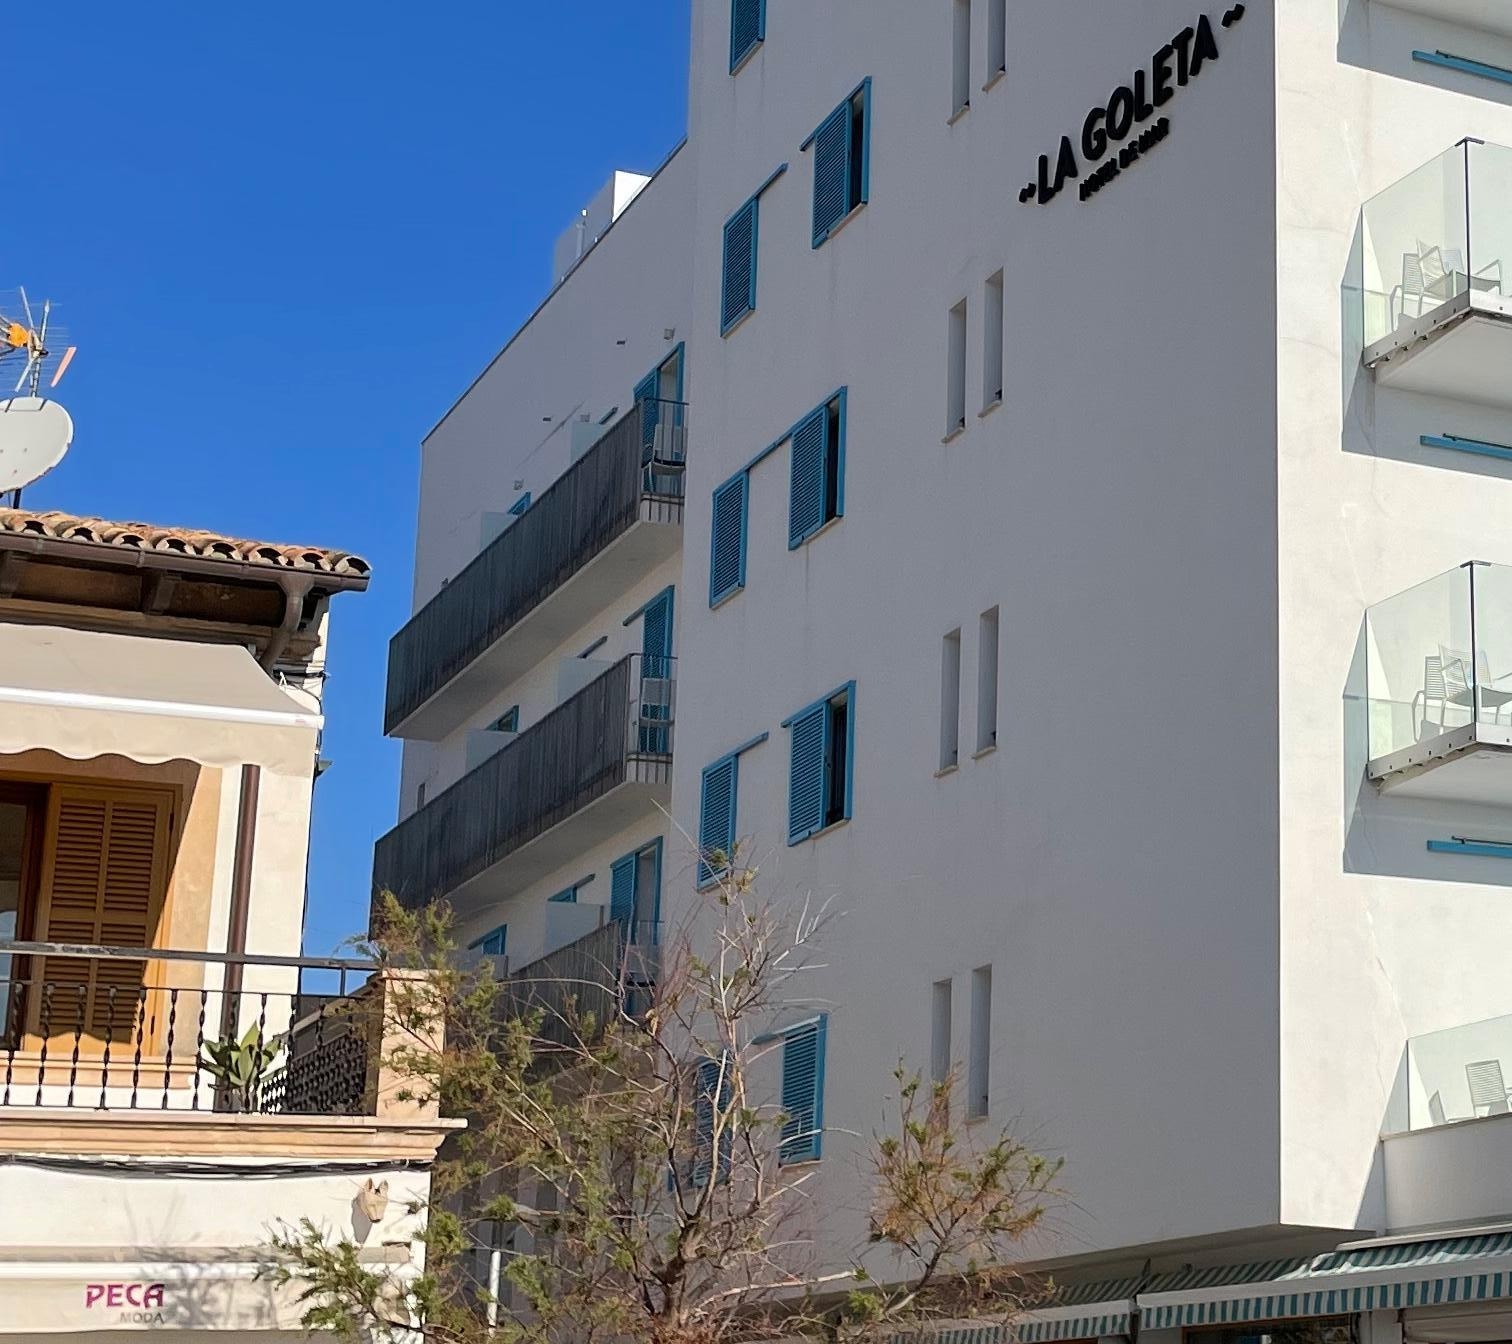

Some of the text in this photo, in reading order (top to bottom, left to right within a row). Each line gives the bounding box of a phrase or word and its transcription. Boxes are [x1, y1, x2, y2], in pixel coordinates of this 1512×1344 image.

[1038, 14, 1219, 204] LA GOLETA
[86, 1283, 165, 1308] PECA
[120, 1312, 165, 1324] MODA
